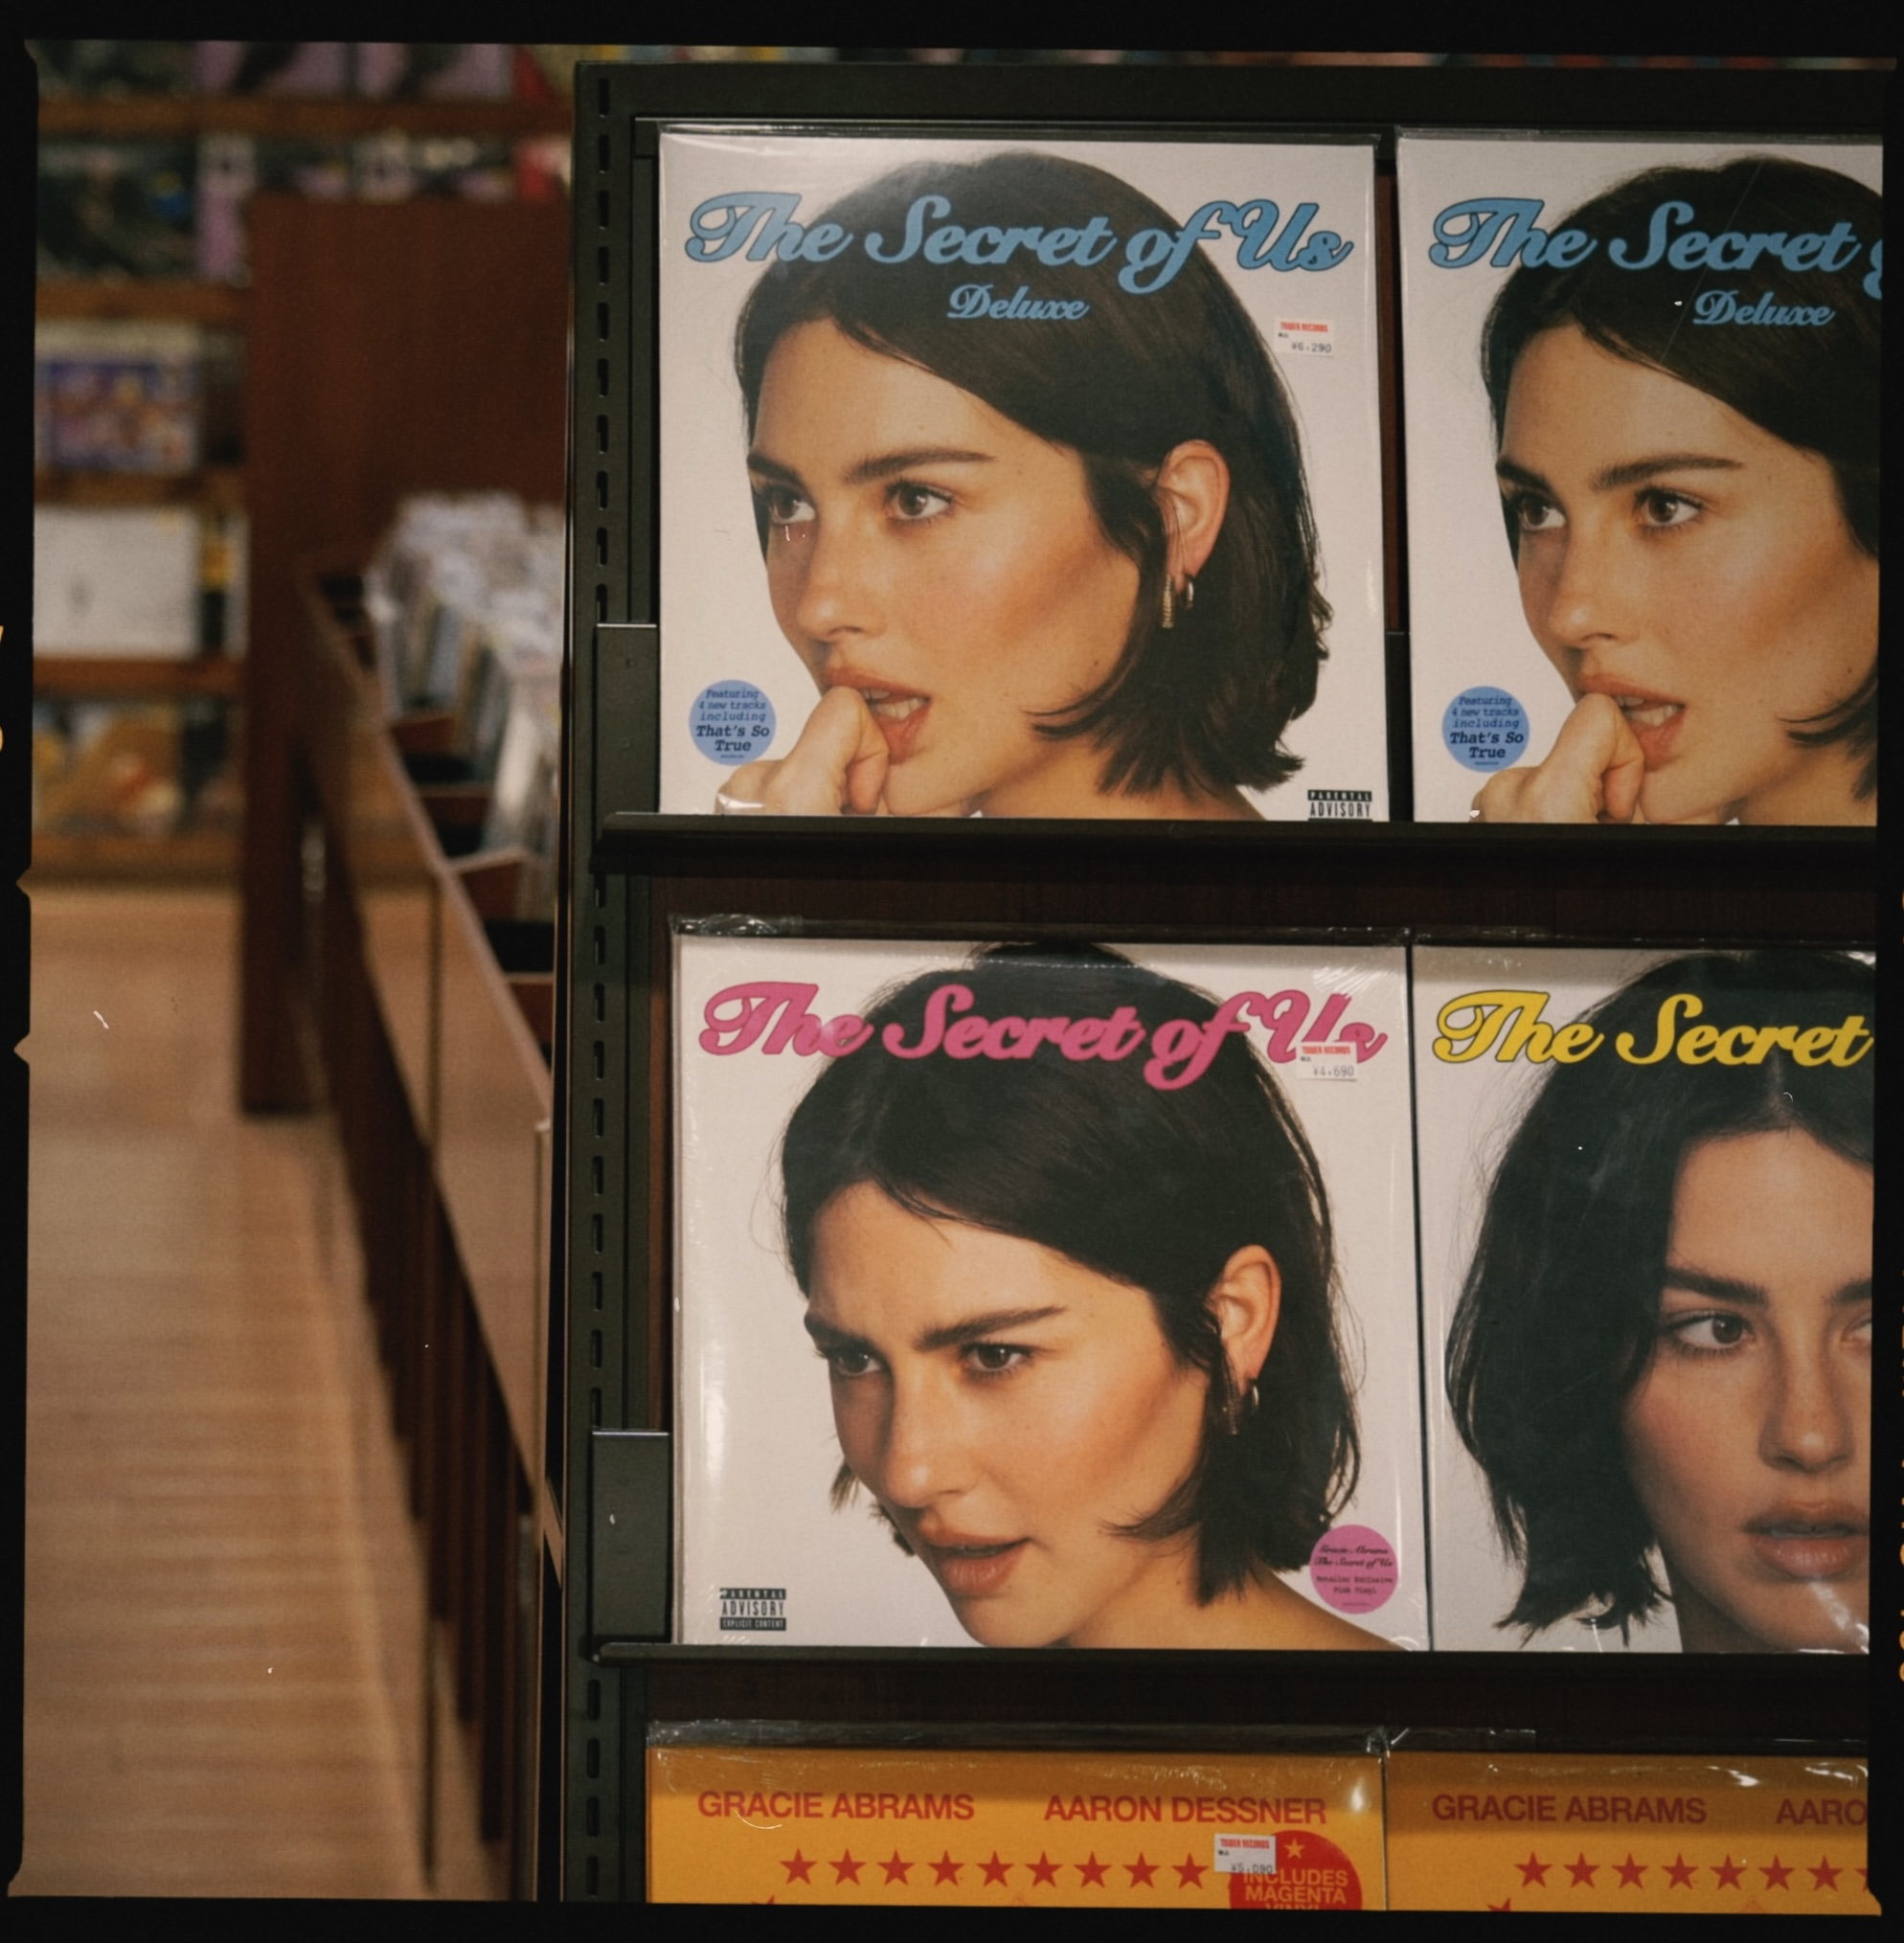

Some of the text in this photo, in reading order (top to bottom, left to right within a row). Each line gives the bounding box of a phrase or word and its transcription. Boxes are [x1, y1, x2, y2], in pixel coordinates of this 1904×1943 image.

[1428, 197, 1598, 268] The
[1608, 201, 1863, 271] Secret
[684, 192, 1354, 295] The Secret of Us
[947, 283, 1090, 321] Deluxe
[1692, 290, 1835, 327] Deluxe
[706, 689, 759, 700] Featuring
[1459, 695, 1512, 707] Featuring
[730, 701, 766, 710] tracks
[1484, 708, 1519, 716] tracks
[700, 712, 766, 722] including
[1454, 718, 1519, 730] including
[696, 724, 770, 737] That's So
[1450, 731, 1525, 744] That's So
[714, 739, 752, 752] True
[1469, 746, 1507, 758] True
[1310, 791, 1370, 801] PARENTAL
[1310, 802, 1371, 818] ADVISORY
[1432, 989, 1873, 1068] The Secret
[698, 981, 873, 1056] The
[881, 983, 1145, 1061] Secret
[1143, 991, 1267, 1091] of
[721, 1600, 784, 1616] ADVISORY
[698, 1790, 1327, 1824] GRACIE ABRAMS AARON DESSNER
[1432, 1794, 1556, 1822] GRACIE
[1564, 1796, 1708, 1823] ABRAMS
[1247, 1886, 1347, 1904] MAGENTA
